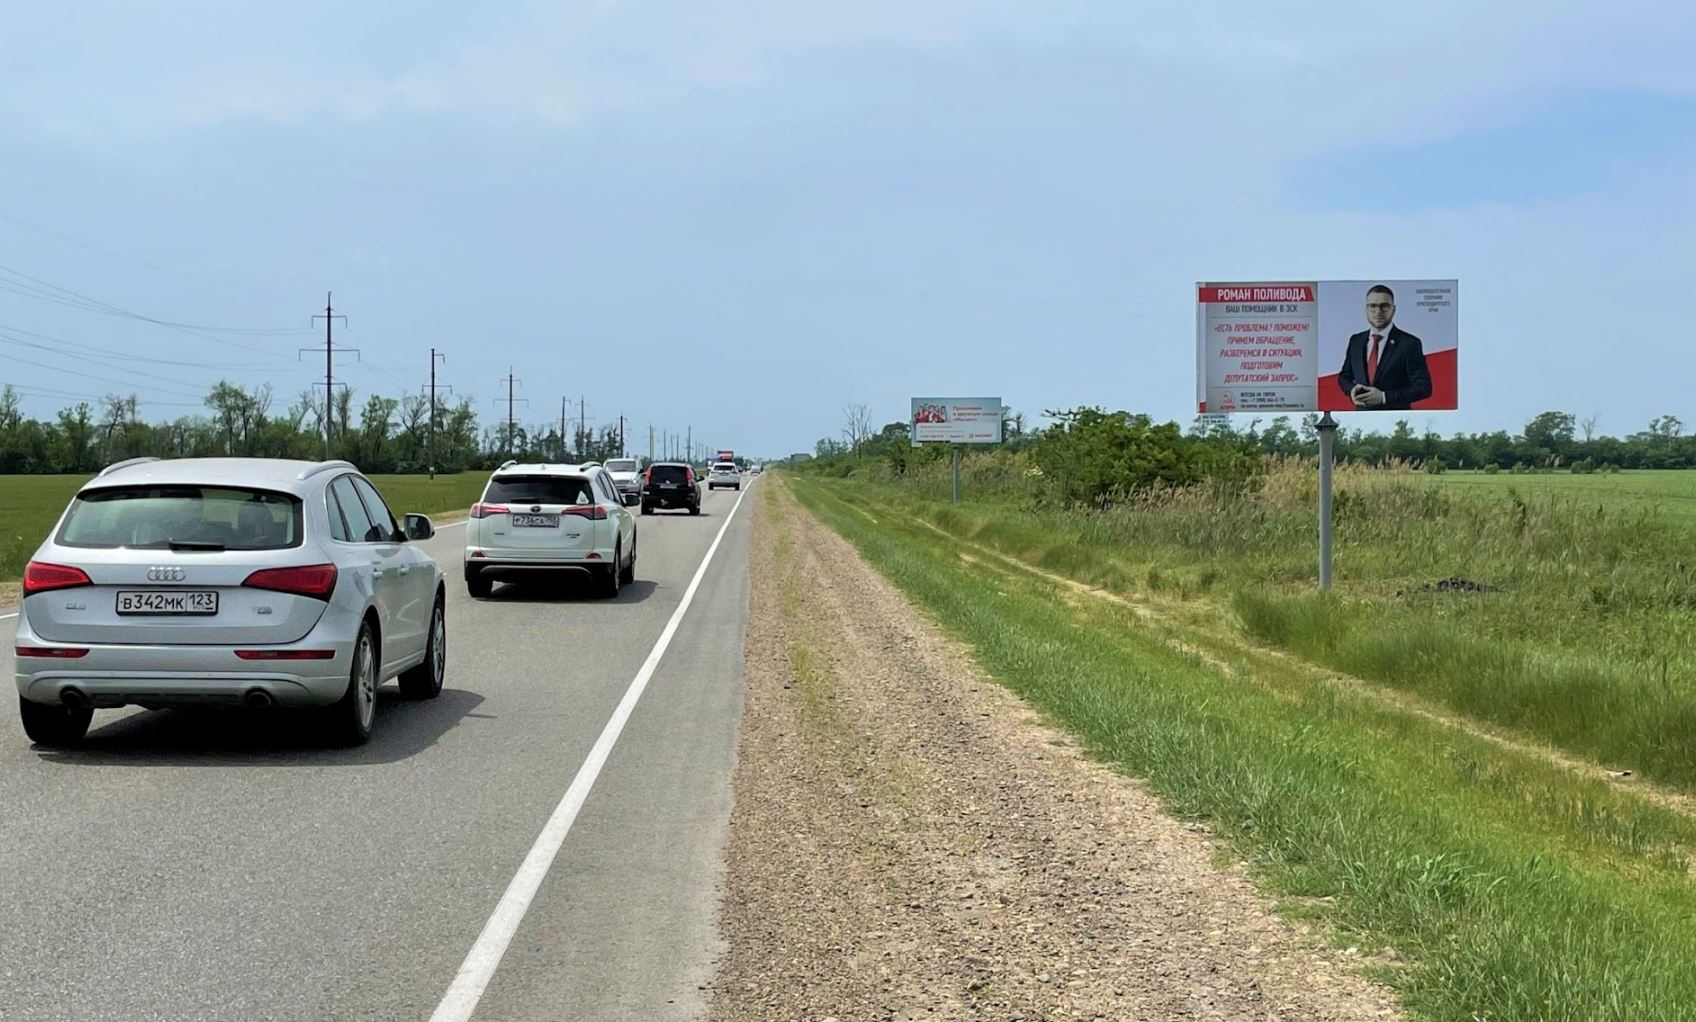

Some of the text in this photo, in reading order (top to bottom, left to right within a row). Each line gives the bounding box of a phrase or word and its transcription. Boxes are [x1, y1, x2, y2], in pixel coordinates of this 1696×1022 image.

[1217, 287, 1306, 301] РОМАН ПОЛИВОДА
[1225, 305, 1239, 313] ВАШ
[1241, 304, 1278, 314] ПОМОЩНИК
[1279, 305, 1284, 313] В
[1234, 323, 1272, 332] ПРОБЛЕМА?
[1227, 336, 1255, 345] ПРИМЕМ
[1219, 349, 1261, 358] РАЗБЕРЕМСЯ
[1262, 349, 1267, 357] В
[1240, 361, 1283, 370] ПОДГОТОВИМ
[1224, 372, 1269, 384] ДЕПУТАТСКИЙ
[123, 593, 214, 610] В342МК 123
